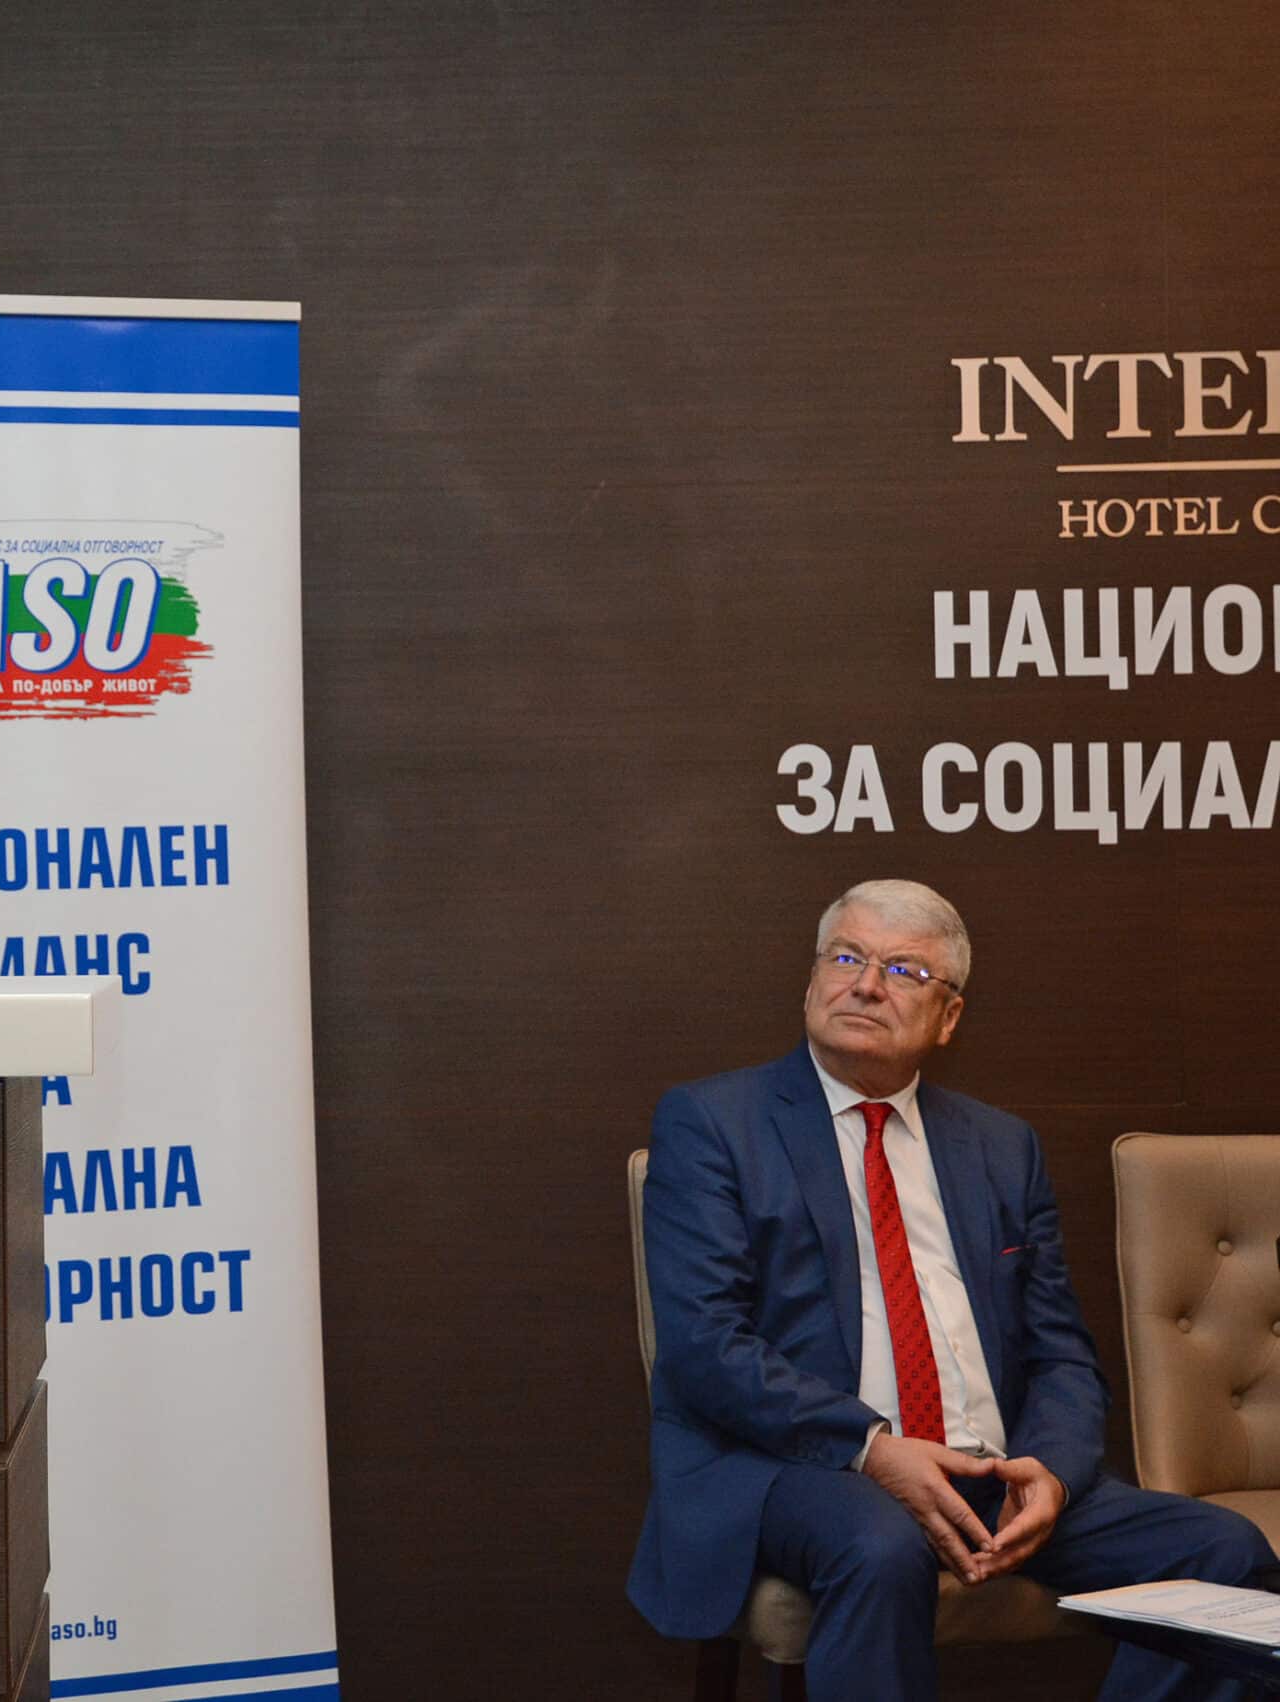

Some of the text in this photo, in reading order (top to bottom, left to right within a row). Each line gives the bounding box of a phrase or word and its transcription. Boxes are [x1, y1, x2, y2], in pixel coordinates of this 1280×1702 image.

[1058, 496, 1240, 538] HOTEL
[4, 539, 19, 553] ЗА
[21, 538, 81, 554] СОЦИАЛНА
[83, 538, 164, 554] ОТГОВОРНОСТ
[933, 583, 1280, 690] НАЦИО
[12, 678, 93, 695] ПО-ДОБЪР
[102, 678, 157, 693] ЖИВОТ
[776, 743, 895, 834] ЗА
[45, 1249, 251, 1324] РНОСТ
[51, 1614, 118, 1641] aso.bg
